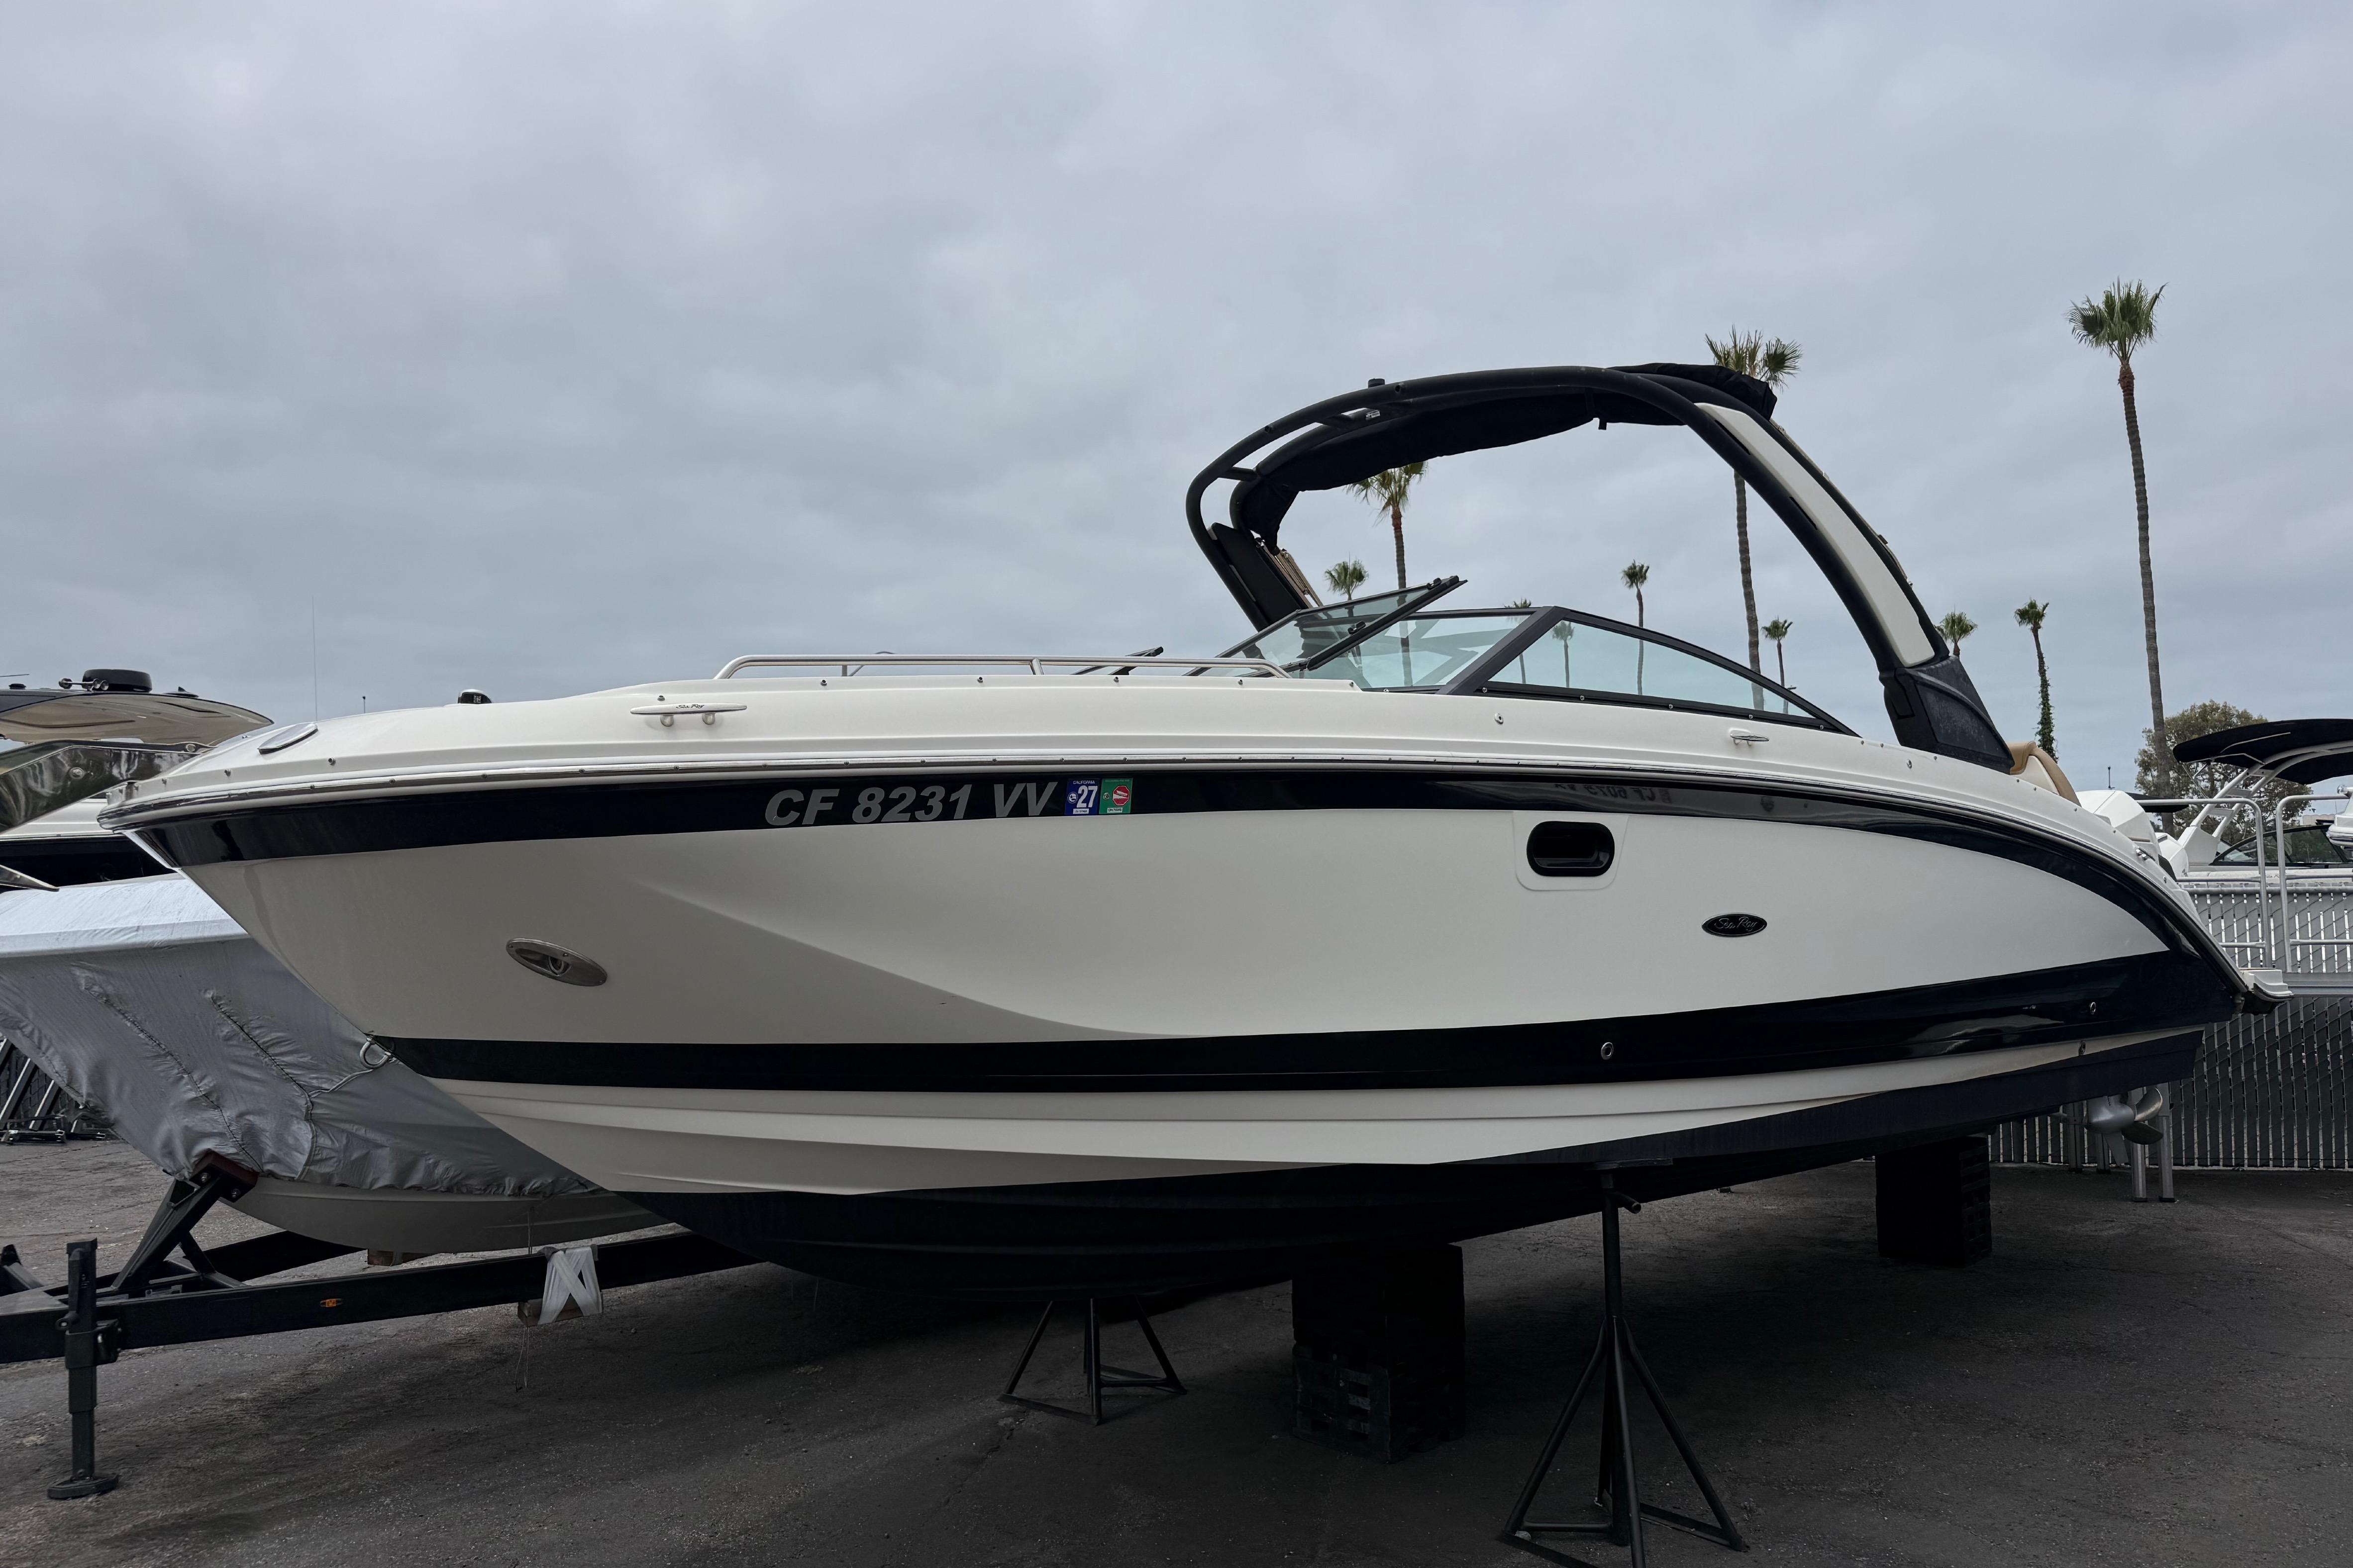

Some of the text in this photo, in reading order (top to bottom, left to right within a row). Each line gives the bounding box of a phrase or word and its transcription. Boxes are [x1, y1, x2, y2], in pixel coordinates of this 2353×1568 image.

[765, 782, 1058, 826] CF 8231 VV
[1076, 785, 1098, 808] 27
[1714, 916, 1758, 932] Sea Ray
